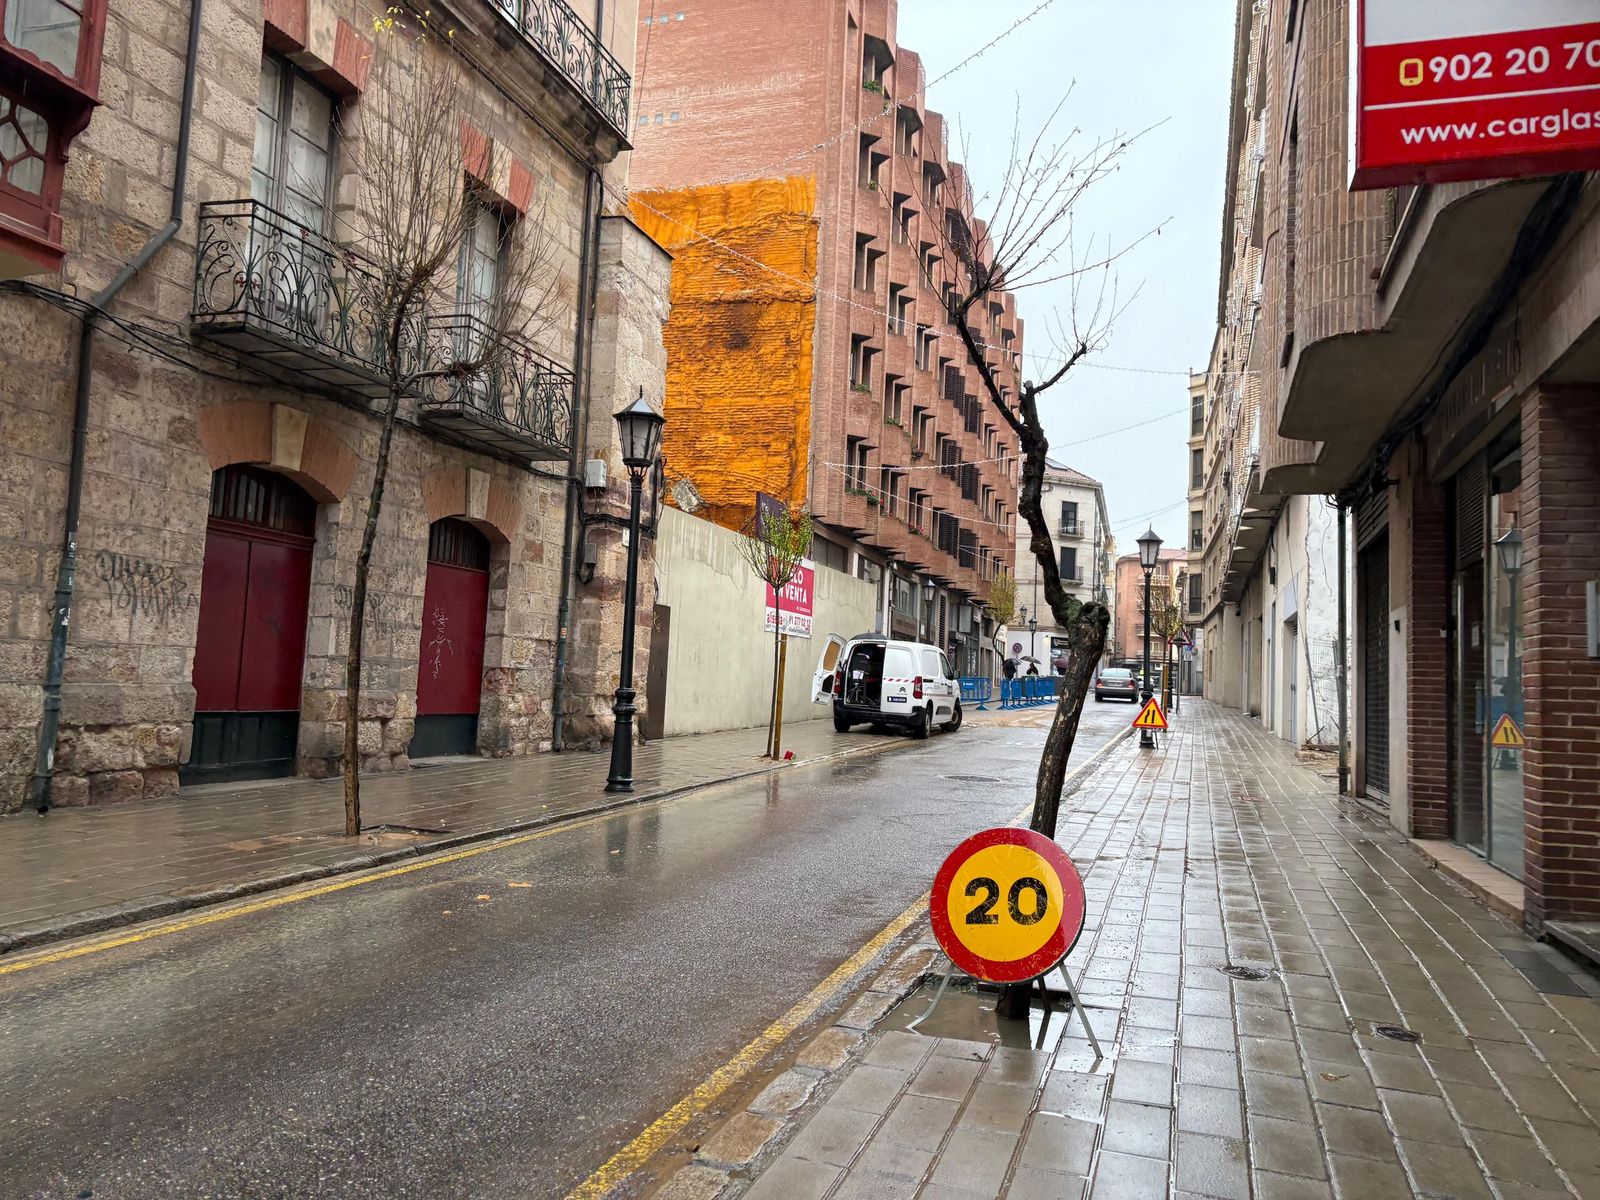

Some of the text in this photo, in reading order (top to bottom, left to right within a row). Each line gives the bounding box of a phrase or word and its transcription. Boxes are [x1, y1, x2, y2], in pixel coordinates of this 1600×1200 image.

[1429, 39, 1600, 83] 902 20 70
[785, 583, 807, 604] VENTA
[964, 876, 1048, 926] 20
